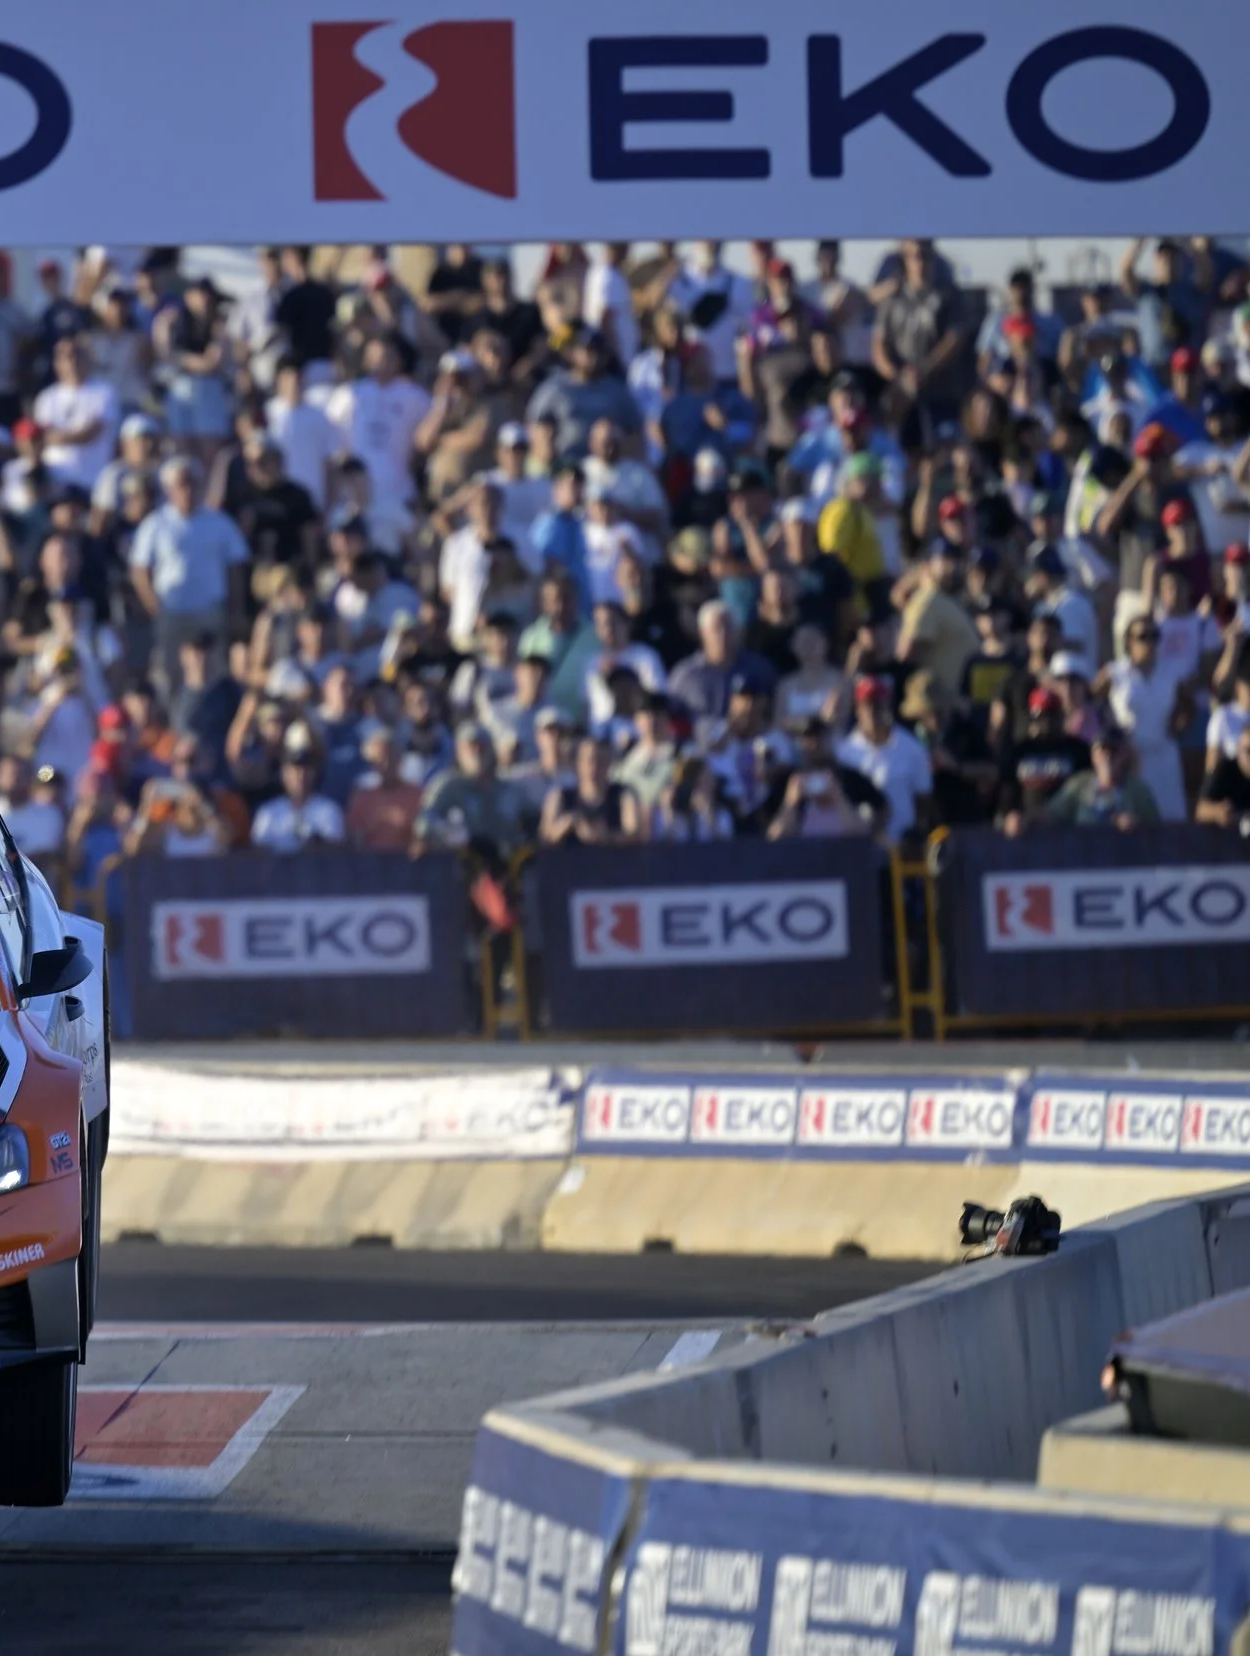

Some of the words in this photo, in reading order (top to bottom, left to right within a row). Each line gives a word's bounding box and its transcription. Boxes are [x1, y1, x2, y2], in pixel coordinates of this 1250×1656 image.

[588, 24, 1211, 183] EKO
[661, 897, 834, 946] EKO
[1073, 880, 1247, 931] EKO
[244, 911, 418, 960] EKO
[618, 1097, 685, 1131] EKO
[724, 1097, 792, 1132] EKO
[832, 1099, 900, 1135] EKO
[941, 1101, 1010, 1137] EKO
[1053, 1102, 1101, 1138] EKO
[1129, 1104, 1178, 1141] EKO
